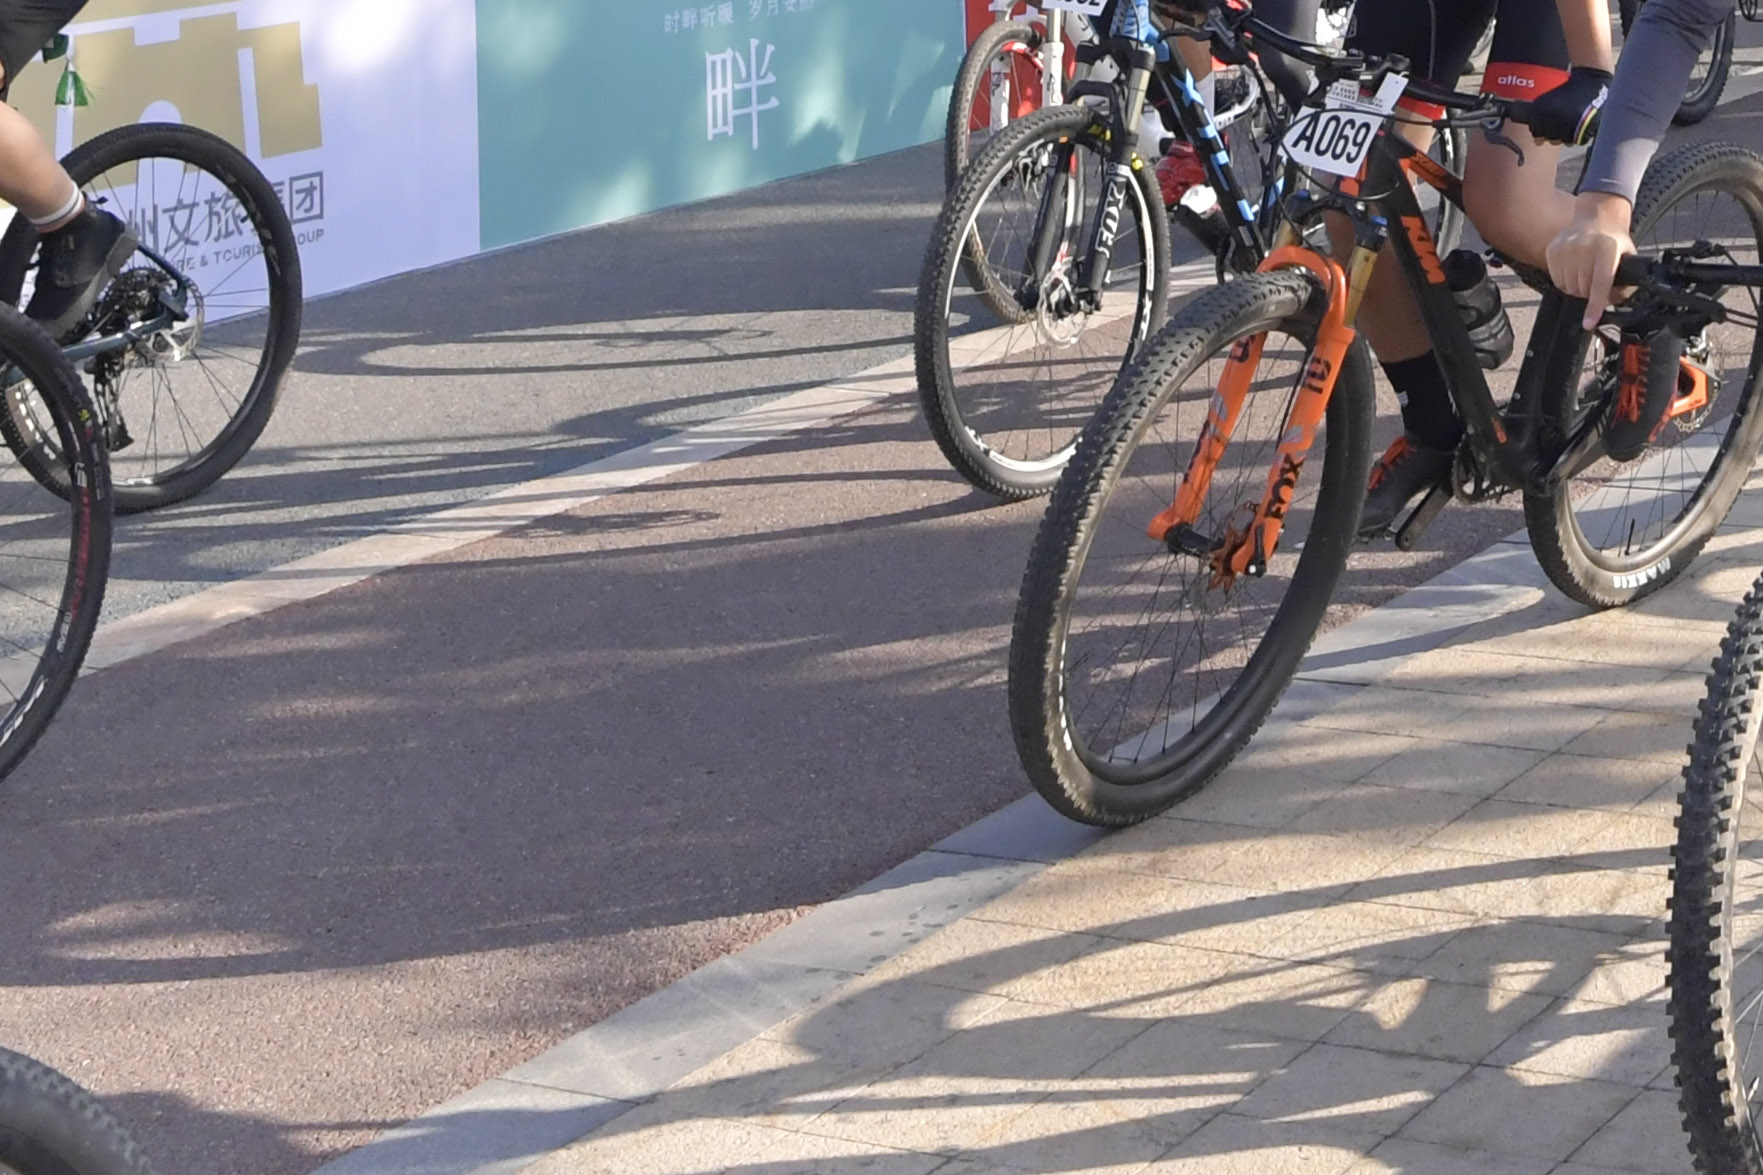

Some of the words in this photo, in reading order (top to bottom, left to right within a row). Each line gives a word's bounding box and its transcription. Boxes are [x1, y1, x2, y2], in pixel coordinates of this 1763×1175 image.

[1497, 74, 1536, 89] atlas
[1291, 112, 1373, 165] A069
[1263, 452, 1308, 520] FOX
[1612, 555, 1672, 590] MAXXIS
